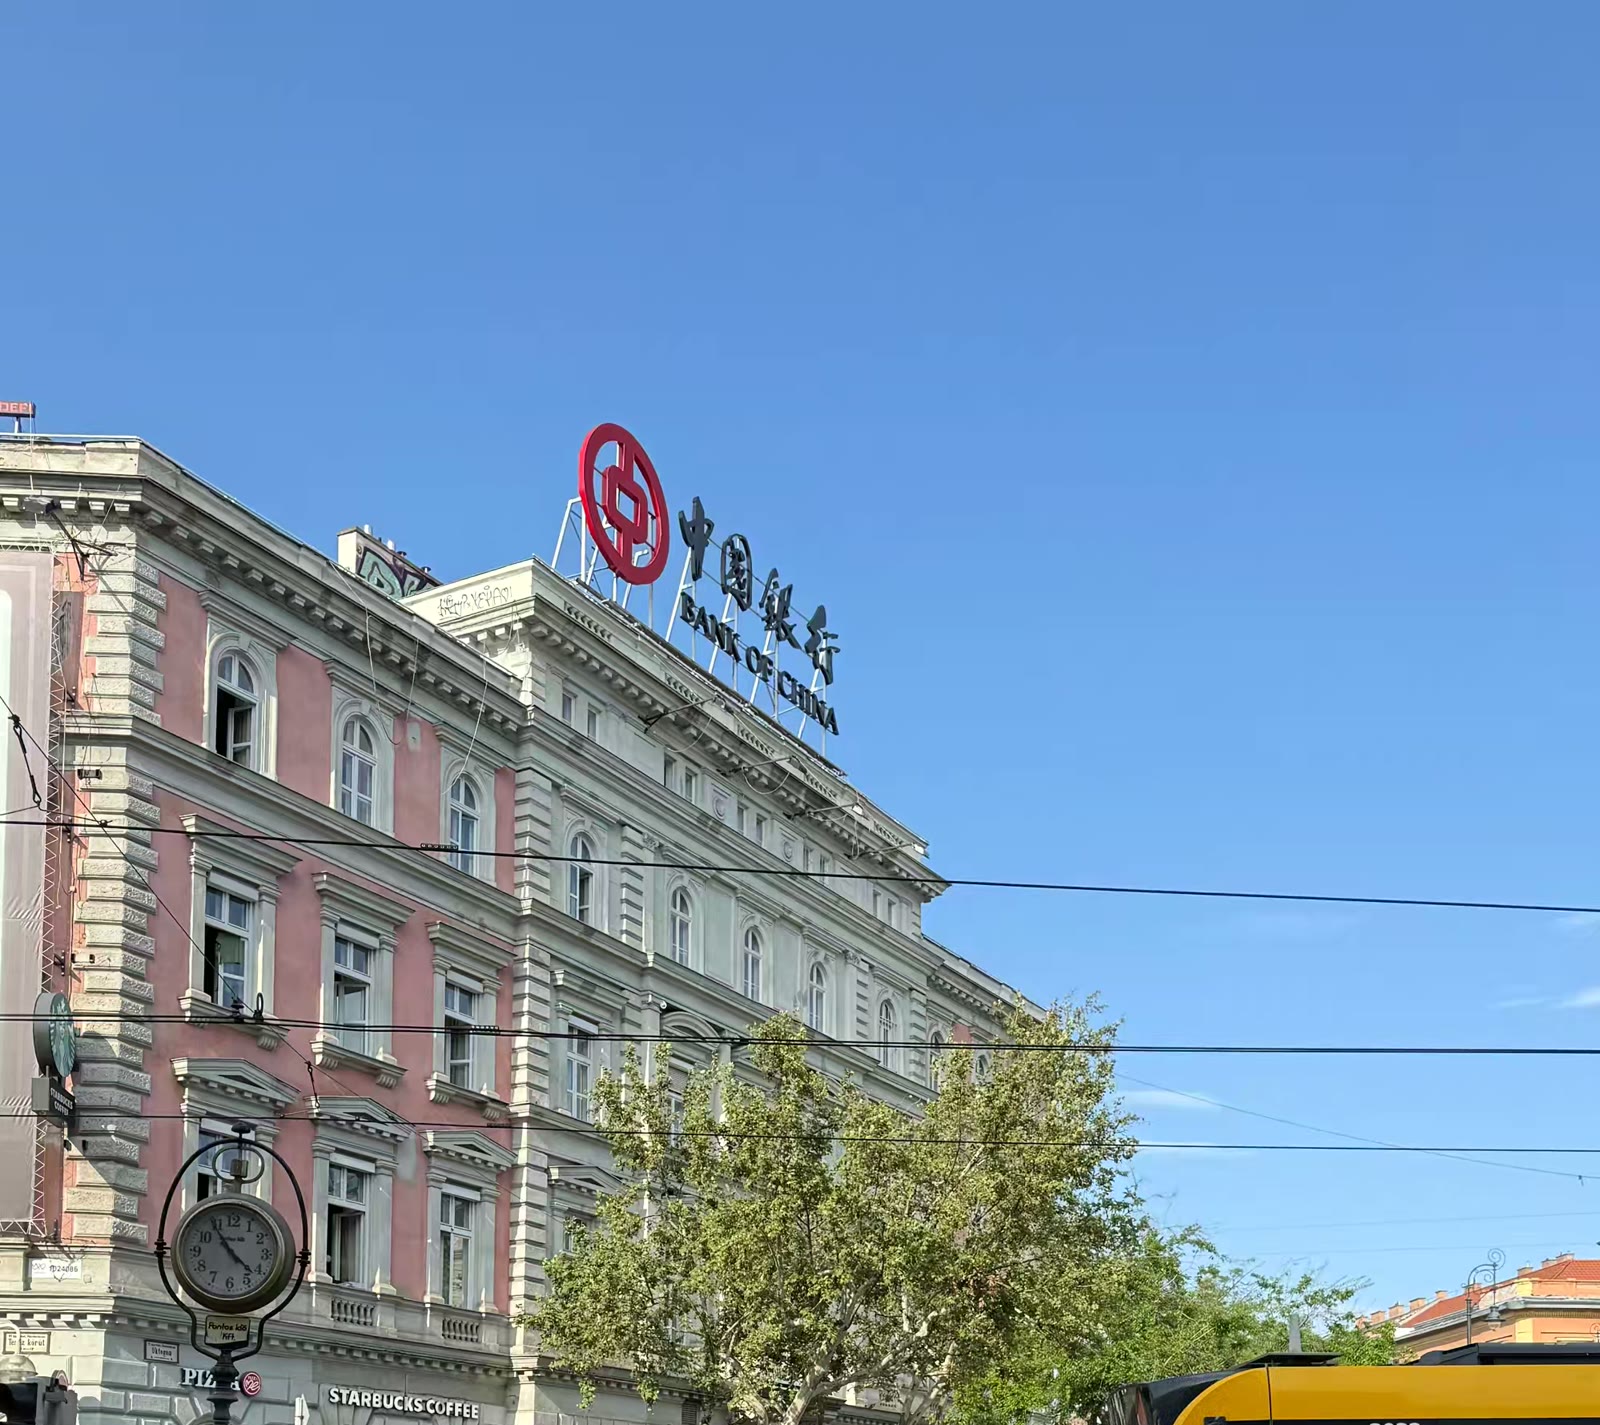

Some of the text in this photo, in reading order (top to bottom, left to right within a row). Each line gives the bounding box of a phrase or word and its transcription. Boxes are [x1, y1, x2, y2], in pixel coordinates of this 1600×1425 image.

[680, 592, 839, 735] BANK OF CHINA
[228, 1215, 240, 1227] 12
[247, 1220, 253, 1232] 1
[200, 1231, 212, 1243] 10
[256, 1232, 264, 1244] 2
[193, 1245, 202, 1257] 9
[261, 1248, 269, 1260] 3
[197, 1260, 206, 1271] 8
[254, 1264, 262, 1275] 4
[209, 1271, 218, 1283] 7
[225, 1276, 234, 1288] 6
[243, 1273, 251, 1285] 5
[329, 1387, 479, 1419] STARBUCKS COFFEE
